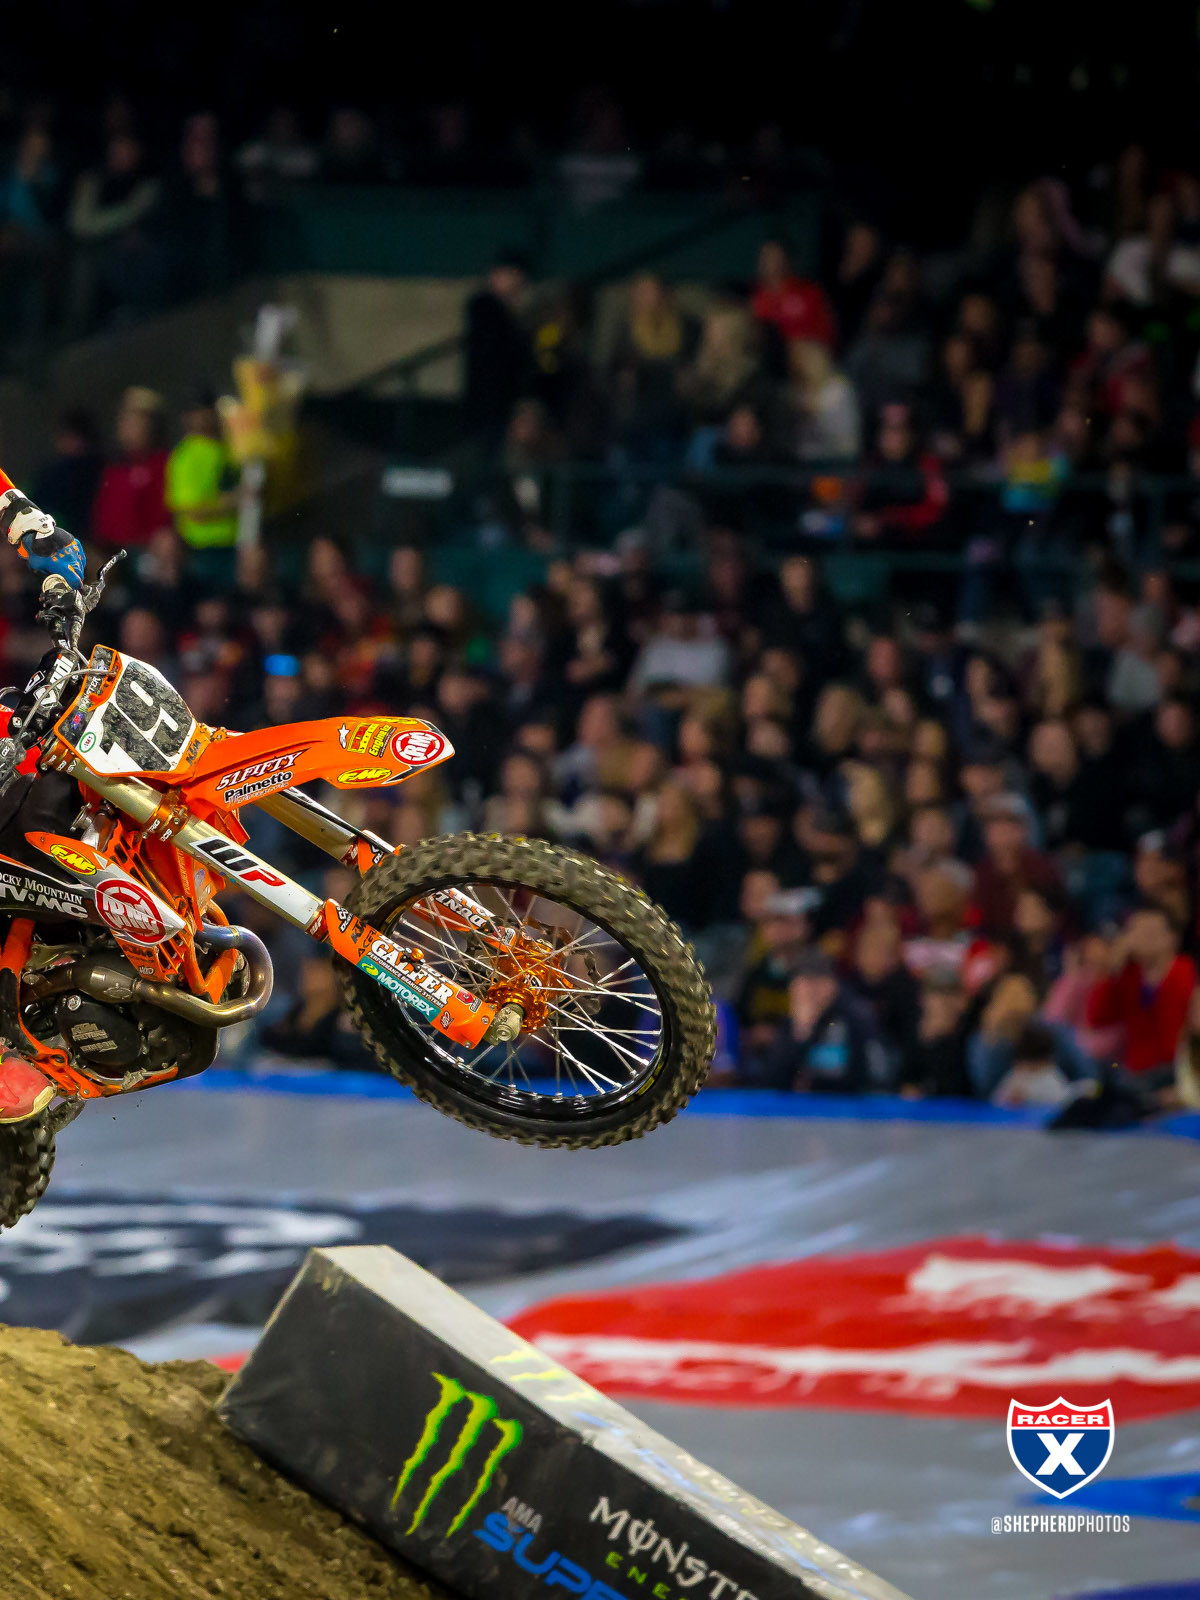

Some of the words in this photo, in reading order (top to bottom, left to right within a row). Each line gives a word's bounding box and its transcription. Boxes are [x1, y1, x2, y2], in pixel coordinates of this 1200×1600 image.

[100, 660, 194, 773] 19
[216, 750, 305, 791] 51FIFTY
[224, 771, 293, 803] Palmetto
[338, 767, 392, 784] FMF
[50, 845, 98, 875] FMF
[25, 877, 83, 905] MOUNTAIN
[434, 890, 488, 928] DUNL
[371, 939, 454, 1005] GALFER
[377, 971, 435, 1017] MOTOREX
[501, 1495, 543, 1535] AMA
[605, 1551, 689, 1600] ENE
